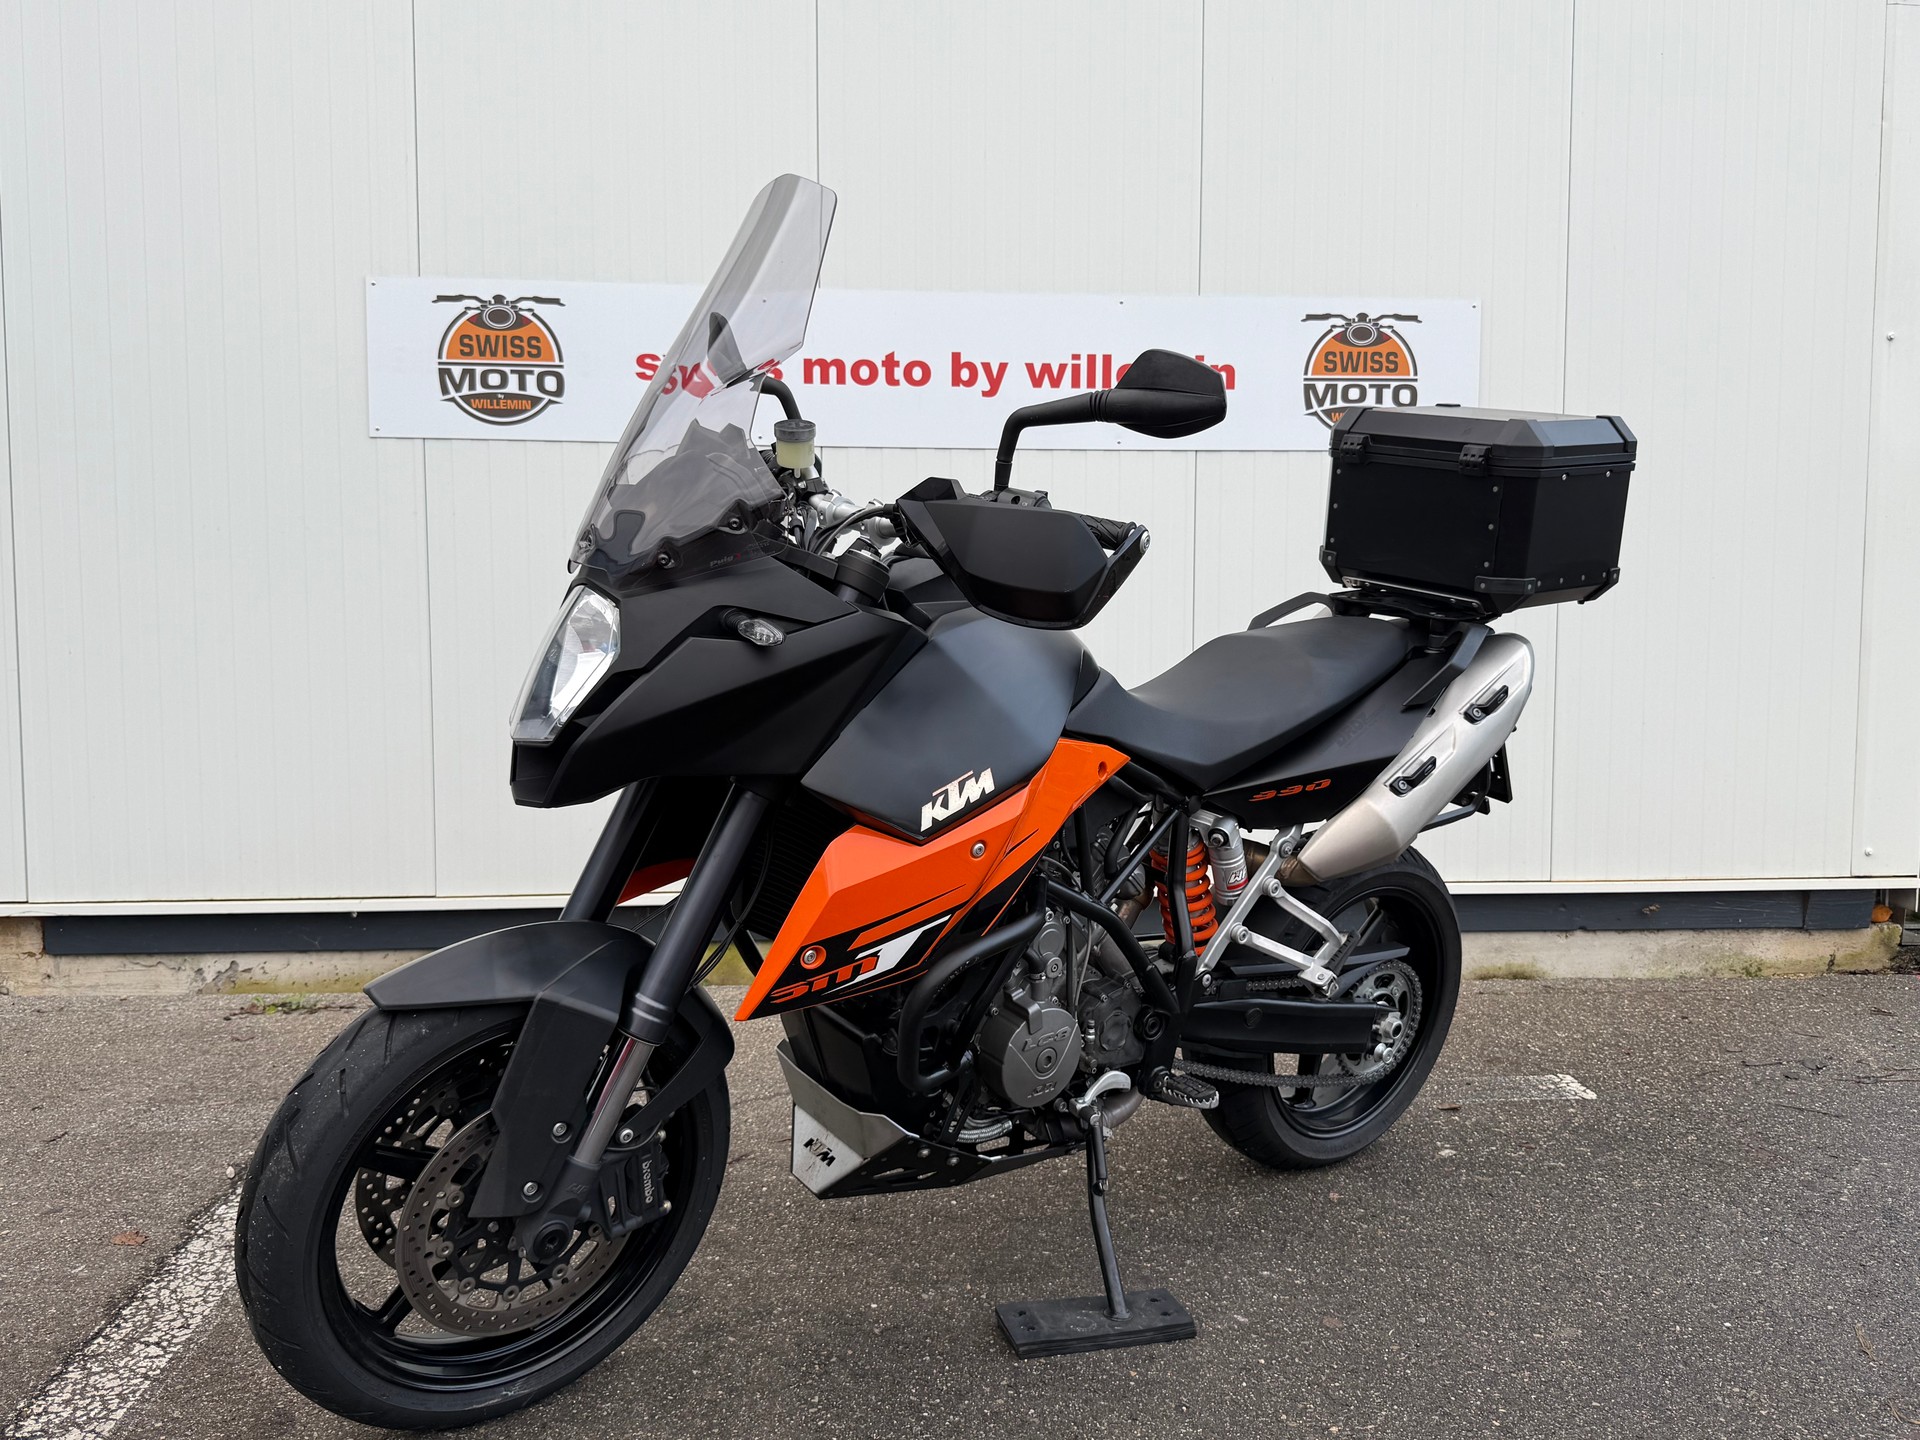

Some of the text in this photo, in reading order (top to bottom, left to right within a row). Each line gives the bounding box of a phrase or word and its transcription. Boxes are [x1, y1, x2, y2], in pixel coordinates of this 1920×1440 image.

[459, 334, 542, 359] SWISS
[802, 351, 932, 388] moto
[950, 352, 1009, 398] by
[1024, 354, 1236, 390] willn
[1323, 351, 1399, 373] SWISS
[438, 367, 565, 398] MOTO
[1302, 383, 1418, 411] MOTO
[471, 399, 532, 410] WILLEMIN
[920, 767, 995, 832] KTM
[1248, 778, 1332, 802] 990
[802, 1137, 836, 1167] KTM
[642, 1160, 655, 1204] brembo
